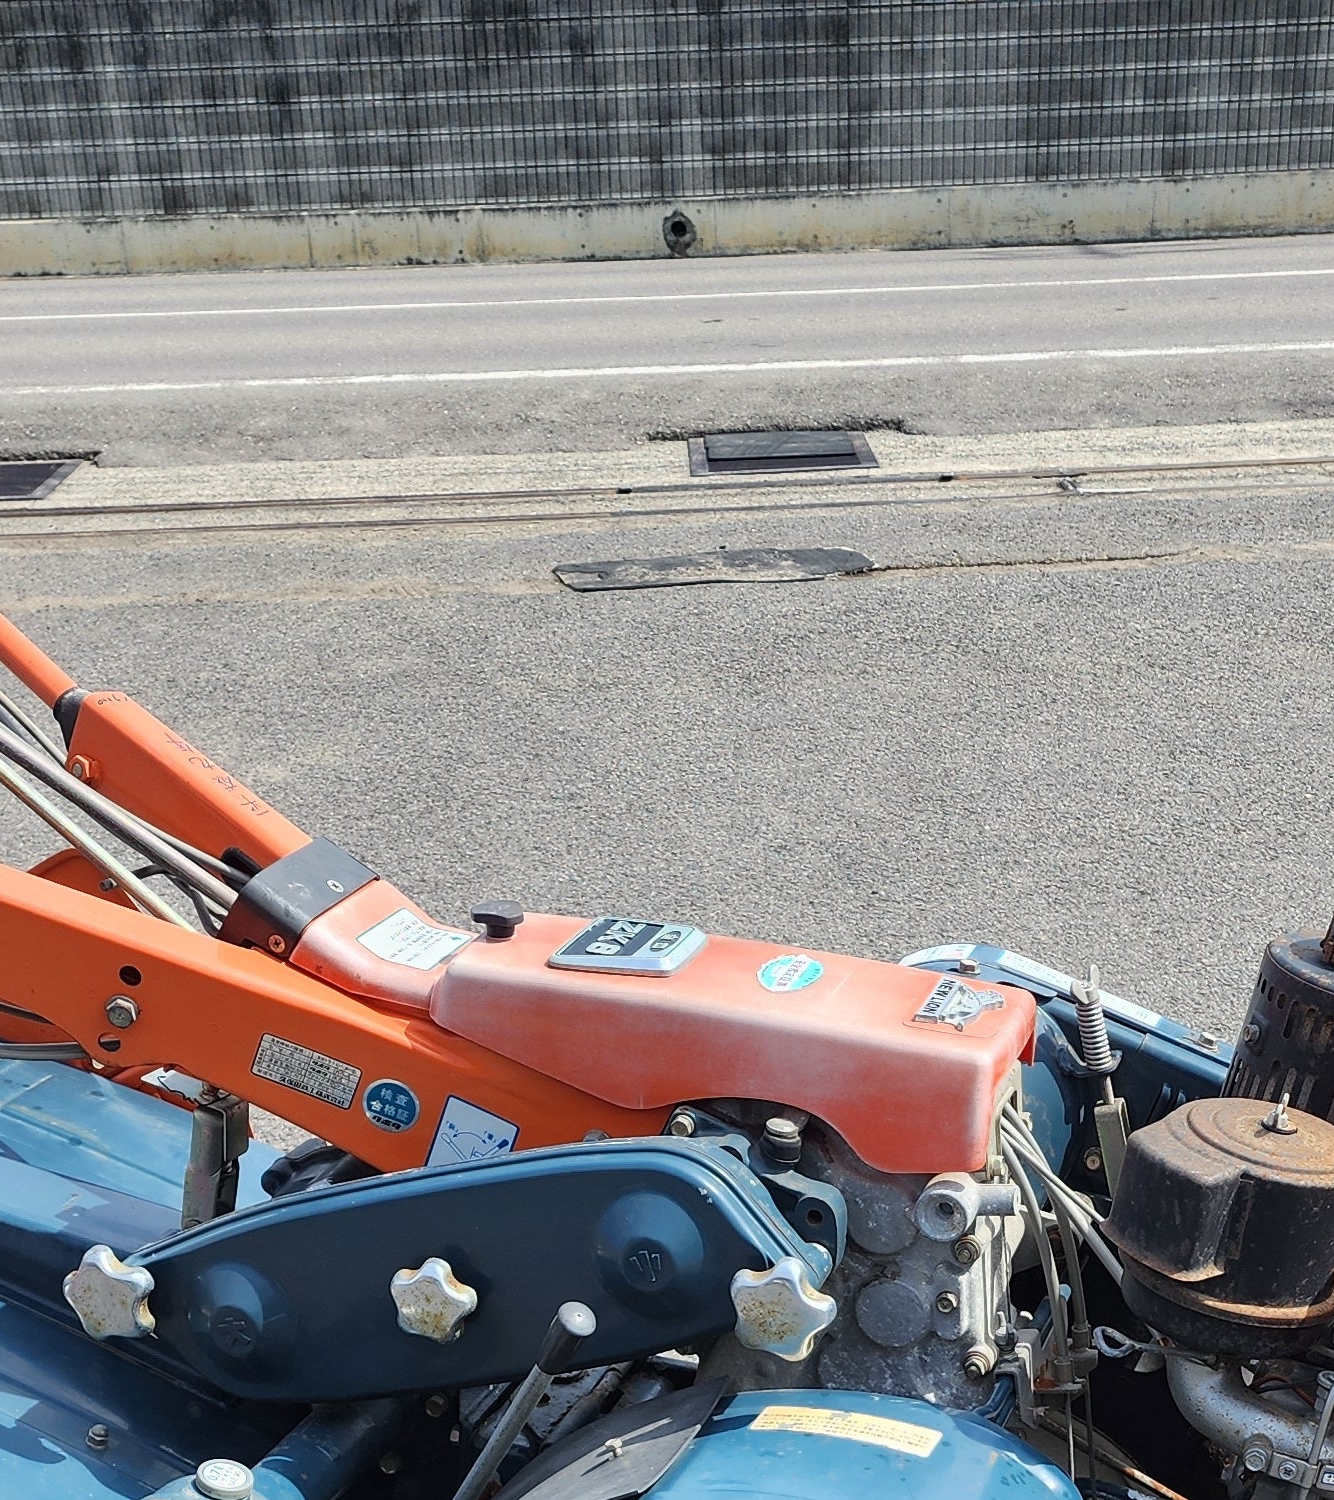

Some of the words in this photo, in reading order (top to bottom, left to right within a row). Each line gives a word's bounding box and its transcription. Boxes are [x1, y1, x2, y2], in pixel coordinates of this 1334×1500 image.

[379, 1086, 410, 1107] 検査
[370, 1098, 409, 1121] 合格証
